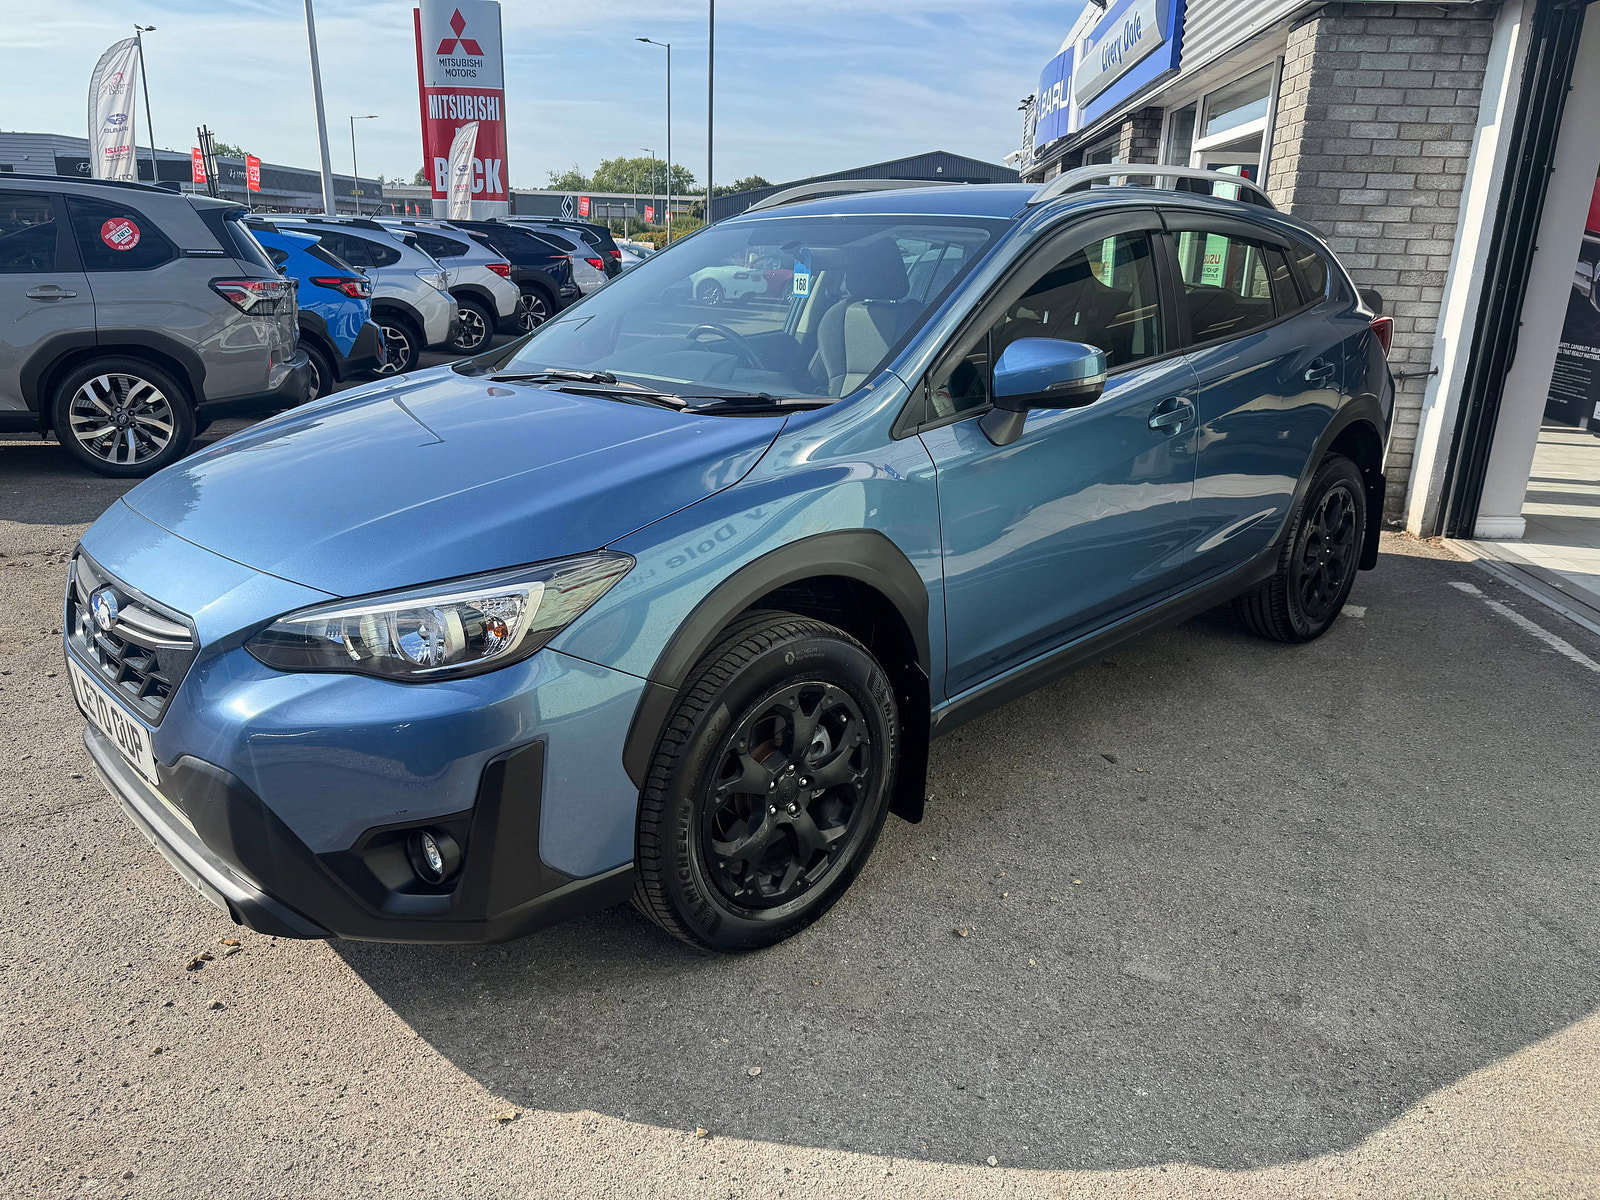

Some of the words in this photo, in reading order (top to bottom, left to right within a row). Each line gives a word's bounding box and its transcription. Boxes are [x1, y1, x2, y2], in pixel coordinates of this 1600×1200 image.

[1102, 35, 1122, 72] Livery
[1123, 11, 1142, 52] Dole
[438, 58, 483, 68] MITSUBISHI
[445, 68, 477, 78] MOTORS
[428, 94, 500, 121] MITSUBISHI
[1037, 76, 1072, 122] BARU
[434, 157, 503, 194] BCK
[796, 278, 806, 291] 168
[677, 805, 701, 904] MICHELIN
